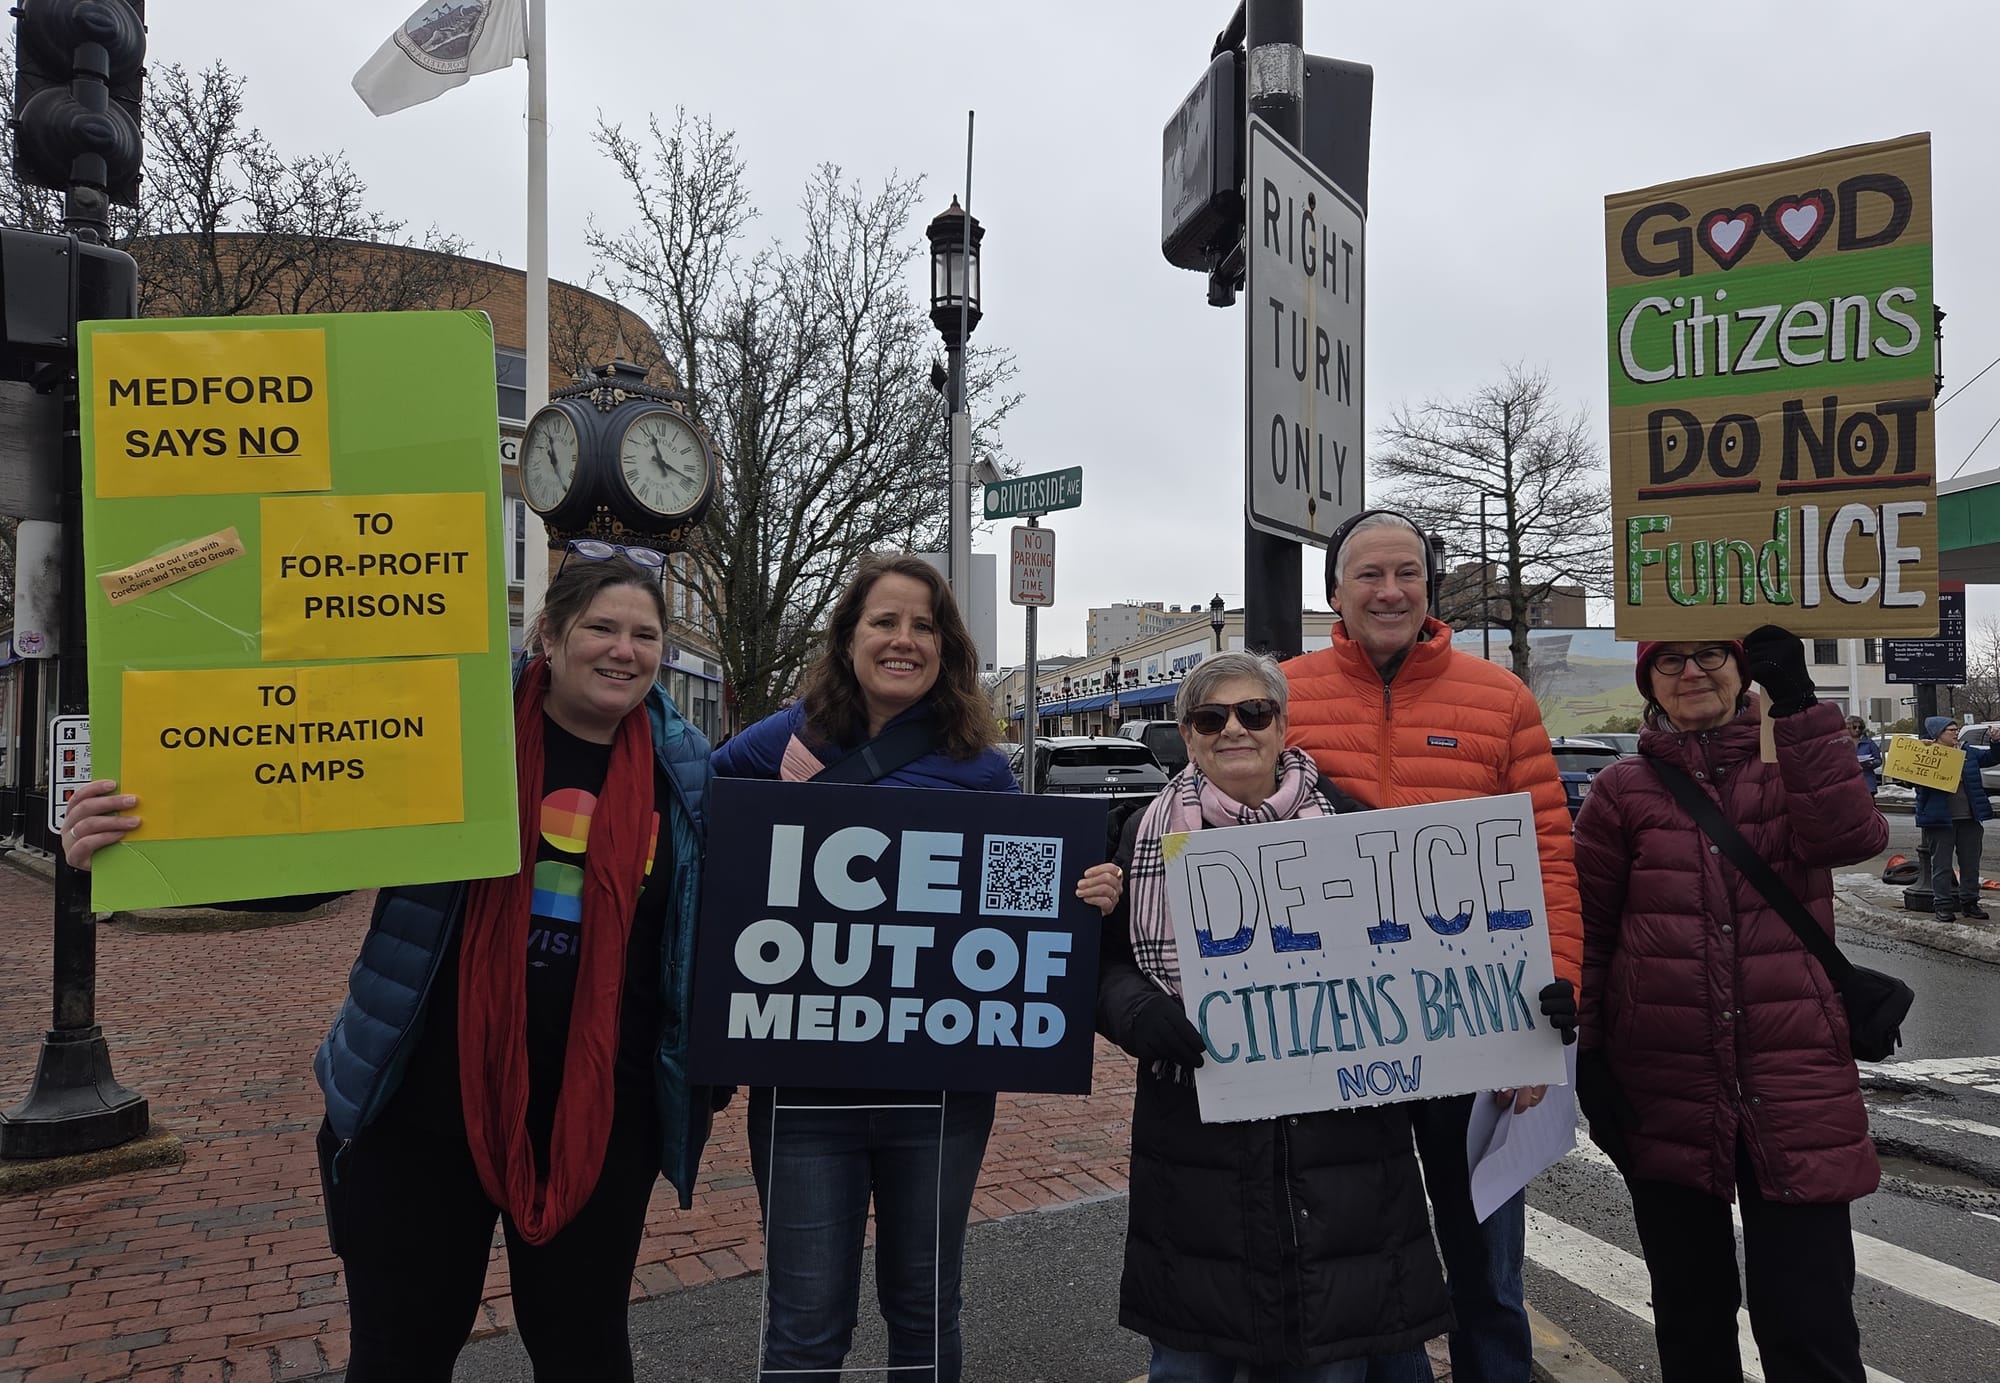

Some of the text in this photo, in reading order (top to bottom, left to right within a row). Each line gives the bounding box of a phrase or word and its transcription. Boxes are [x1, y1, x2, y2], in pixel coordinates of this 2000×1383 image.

[1263, 176, 1353, 304] RIGHT
[1269, 296, 1351, 407] TURN
[1618, 286, 1922, 384] Citizens
[109, 375, 314, 406] MEDFORD
[125, 426, 300, 458] SAYS NO
[1271, 413, 1347, 506] ONLY
[1001, 475, 1080, 513] RIVERSIDE AVE
[353, 513, 393, 535] TO
[1014, 552, 1051, 567] PARKING
[1024, 535, 1042, 550] NO
[1625, 501, 1928, 609] Fund ICE
[111, 546, 238, 600] CoreCivic and The GEO Group.
[119, 540, 220, 585] It's time to cut ties with
[281, 551, 469, 579] FOR-PROFIT
[1023, 568, 1041, 578] ANY
[1021, 580, 1043, 591] TIME
[304, 593, 446, 619] PRISONS
[257, 685, 296, 707] TO
[159, 716, 424, 749] CONCENTRATION
[254, 759, 365, 785] CAMPS
[1915, 753, 1942, 769] STOP!
[1915, 767, 1929, 777] ICE
[767, 824, 964, 914] ICE
[1185, 819, 1534, 958] DE-ICE
[734, 919, 1073, 994] OUT OF
[727, 992, 1066, 1048] MEDFORD
[1199, 960, 1536, 1063] CITIZENS BANK
[1336, 1055, 1422, 1101] NOW
